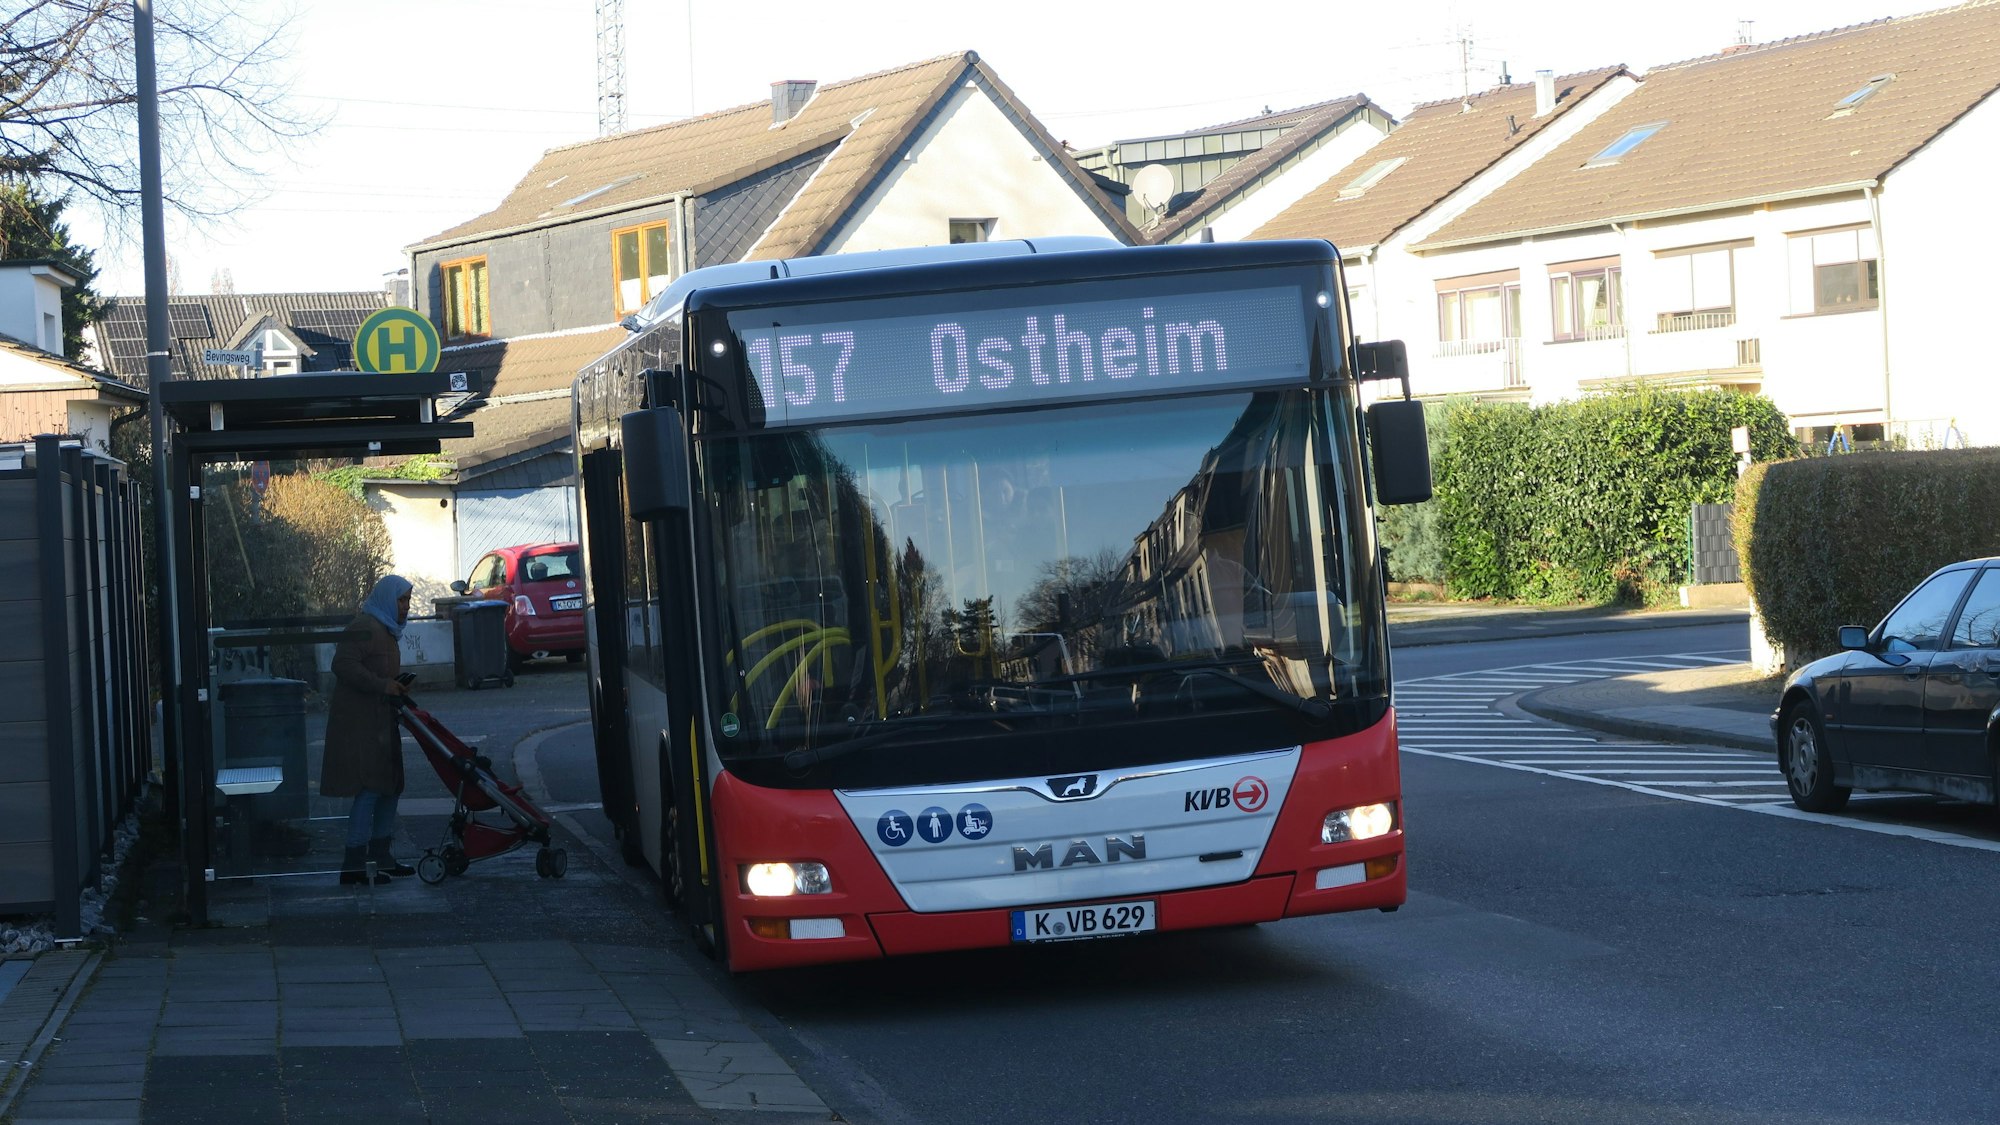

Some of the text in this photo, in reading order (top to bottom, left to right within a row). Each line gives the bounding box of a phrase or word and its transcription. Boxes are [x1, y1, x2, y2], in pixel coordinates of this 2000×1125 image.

[378, 327, 416, 371] H
[749, 306, 1227, 407] 157 Ostheim
[1184, 787, 1231, 812] KVB
[1013, 833, 1147, 871] MAN
[1035, 912, 1051, 935] K
[1067, 909, 1097, 932] VB
[1102, 905, 1145, 930] 629
